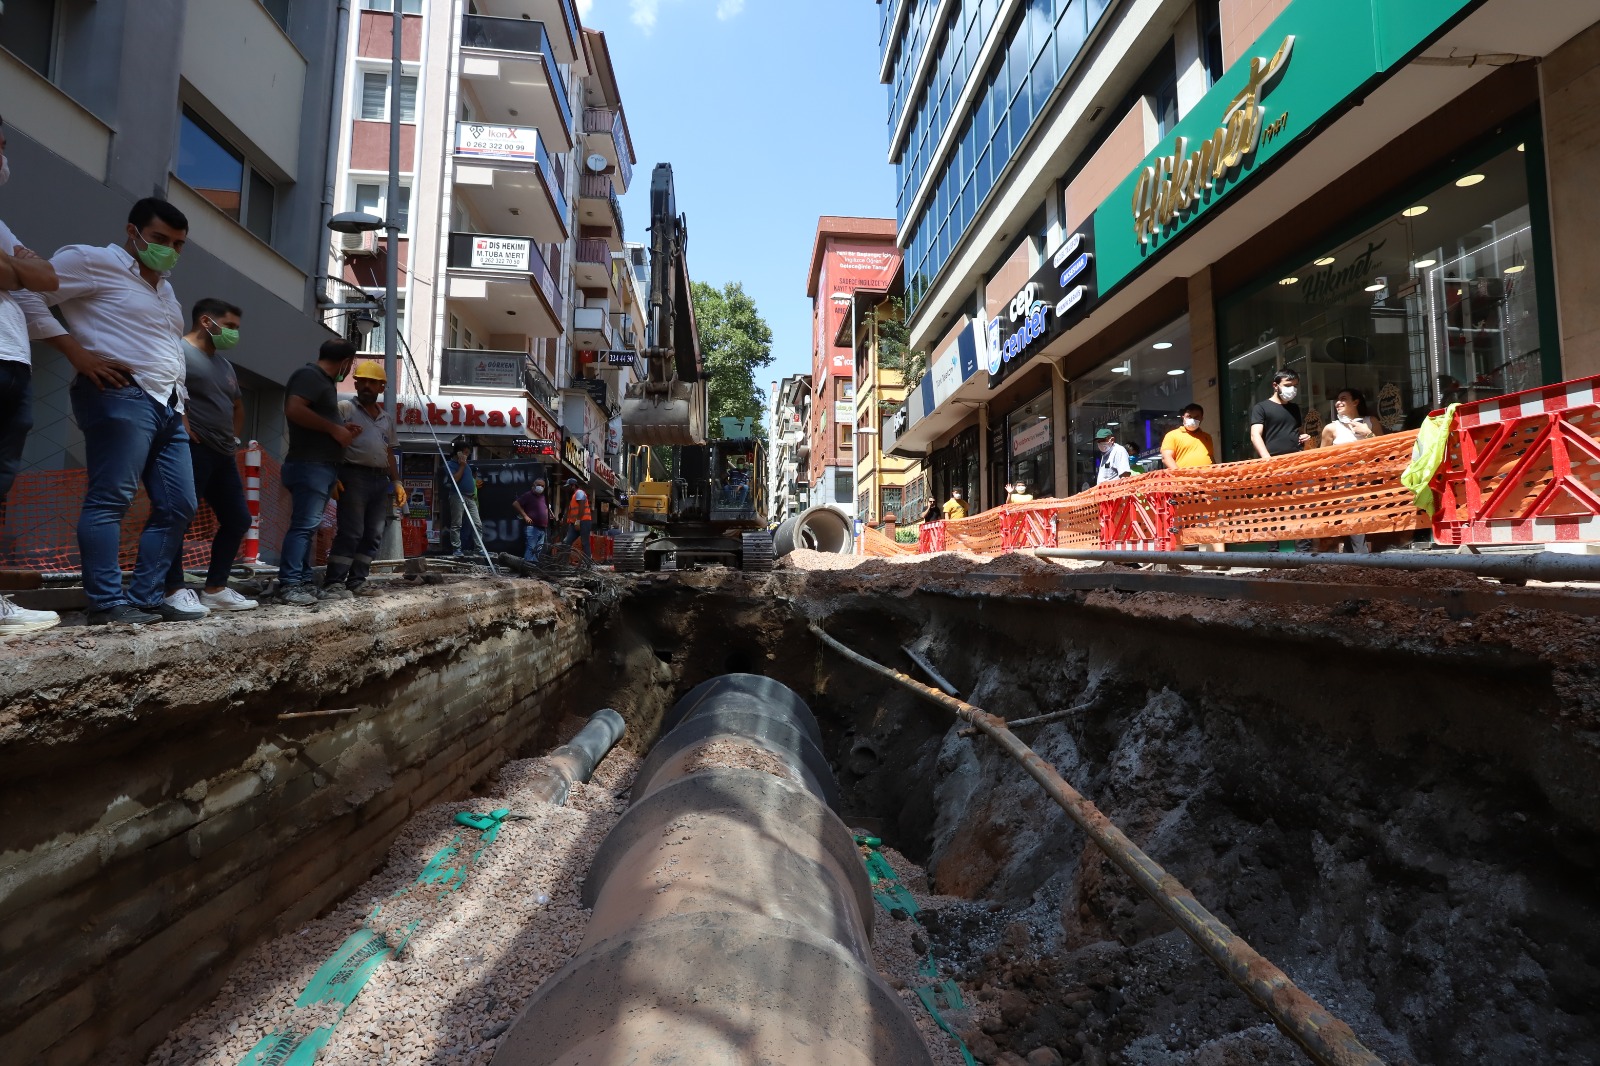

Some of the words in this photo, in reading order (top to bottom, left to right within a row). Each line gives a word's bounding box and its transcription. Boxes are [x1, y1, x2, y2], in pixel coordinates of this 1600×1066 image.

[473, 141, 487, 149] 262
[1132, 35, 1296, 244] Hikmet
[1302, 238, 1386, 304] Hikmet
[1010, 282, 1038, 322] cep
[1002, 304, 1048, 362] center
